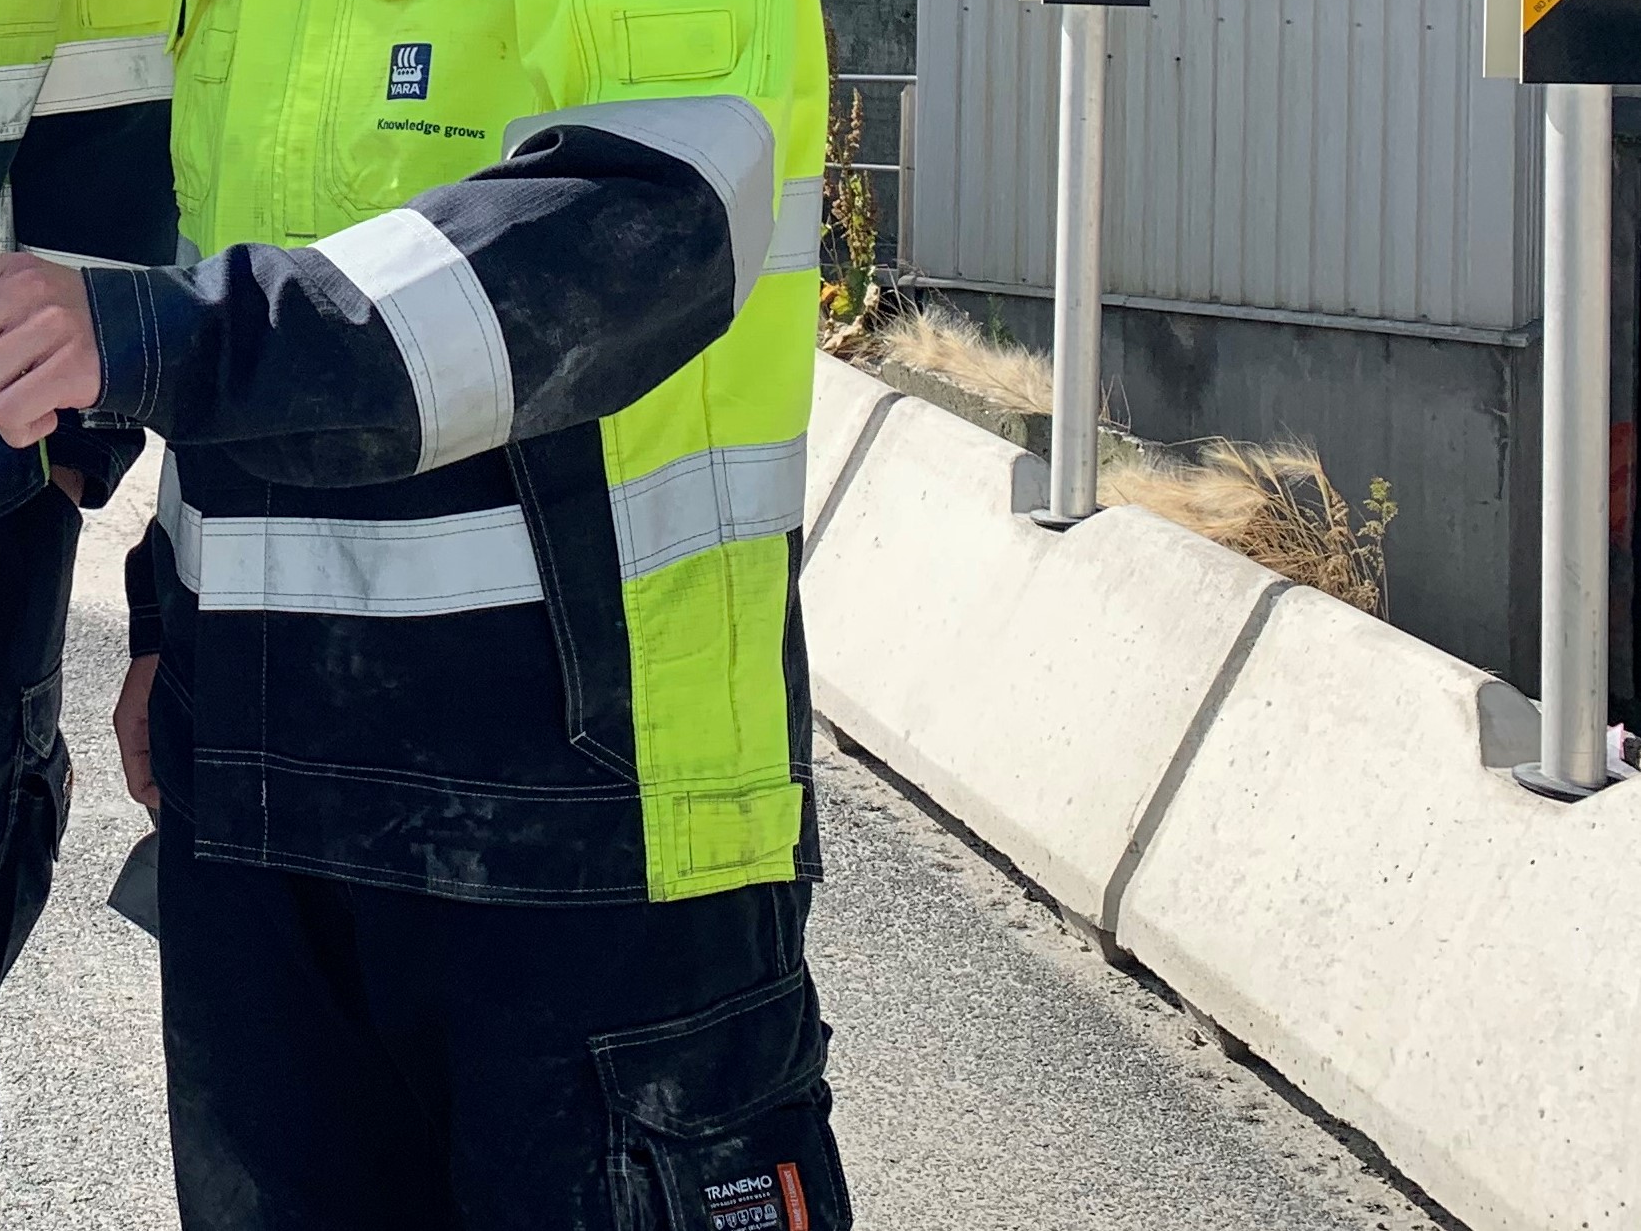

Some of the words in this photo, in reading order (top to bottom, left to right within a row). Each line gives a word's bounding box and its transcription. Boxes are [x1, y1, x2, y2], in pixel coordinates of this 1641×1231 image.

[1533, 0, 1547, 13] BD
[390, 83, 420, 95] YARA
[377, 118, 440, 135] Knowledge
[444, 126, 485, 139] grows
[704, 1175, 772, 1200] TRANEMO
